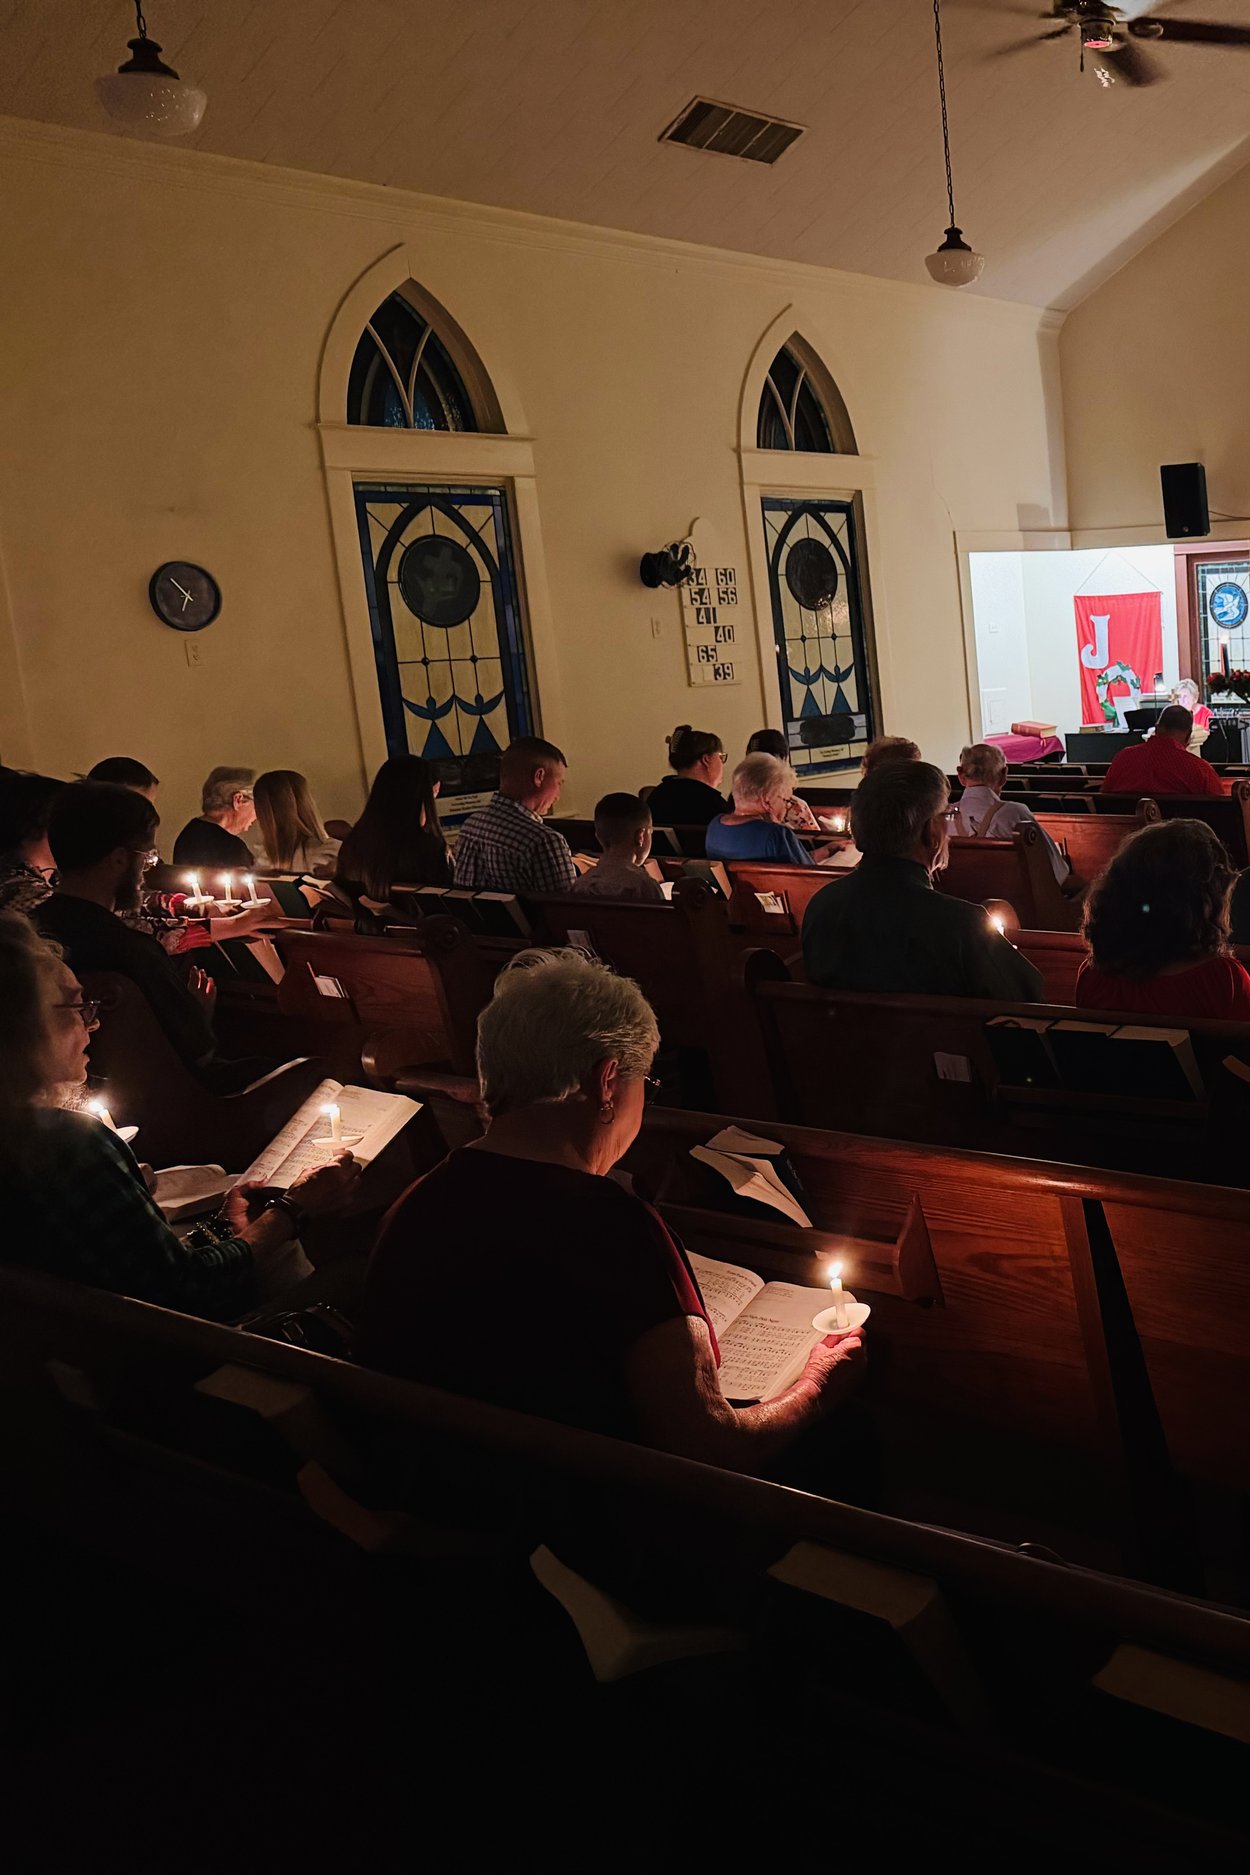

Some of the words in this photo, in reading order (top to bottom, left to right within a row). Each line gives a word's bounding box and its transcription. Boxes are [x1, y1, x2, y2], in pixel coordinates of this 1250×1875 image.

[689, 569, 707, 586] 34
[717, 569, 736, 586] 60
[691, 588, 710, 605] 54
[719, 588, 738, 605] 56
[698, 607, 716, 624] 41
[715, 626, 735, 643] 40
[698, 646, 717, 663] 65
[714, 663, 734, 680] 39
